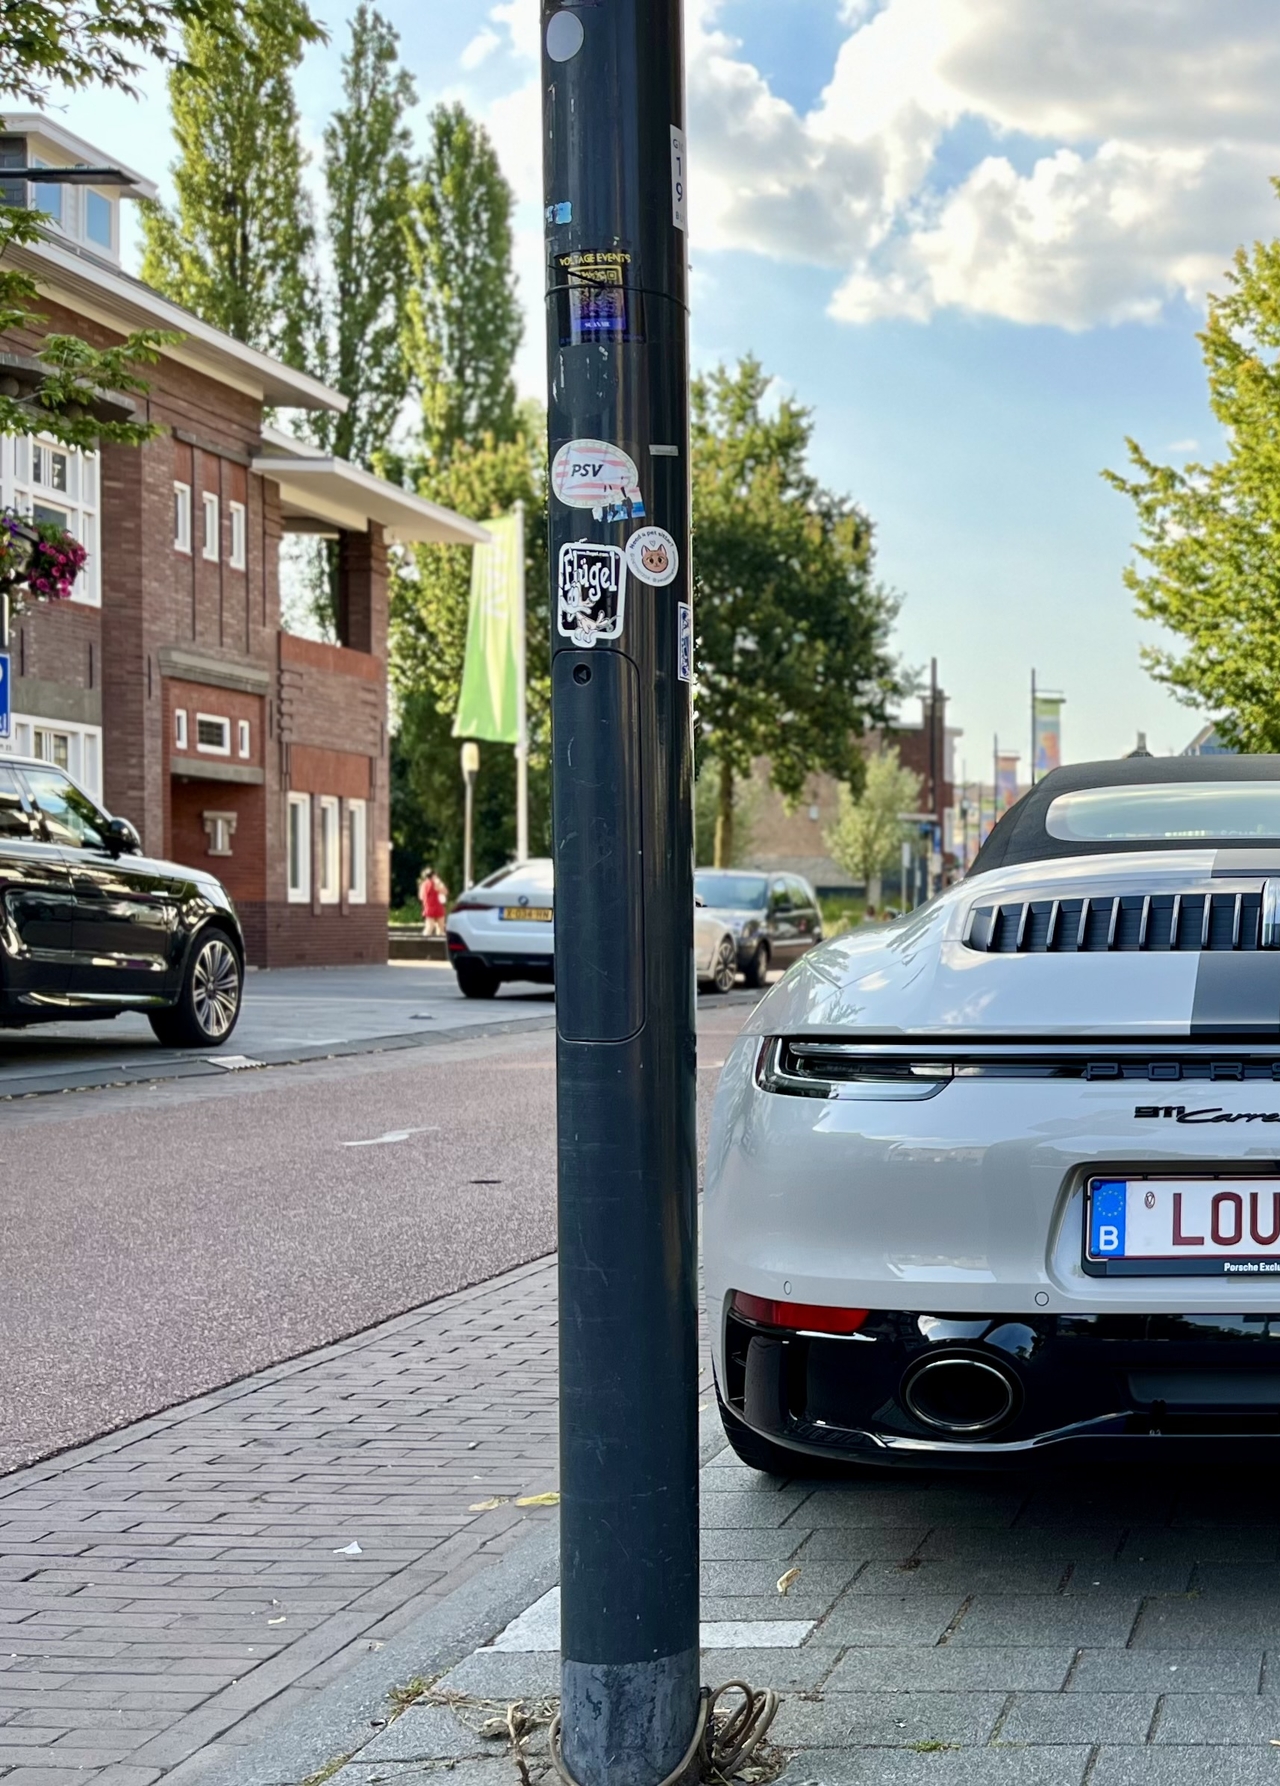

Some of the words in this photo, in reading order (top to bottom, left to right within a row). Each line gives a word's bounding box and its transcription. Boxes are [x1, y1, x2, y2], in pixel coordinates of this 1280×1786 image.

[560, 253, 596, 266] VOLTAGE
[596, 253, 631, 264] EVENTS
[571, 463, 603, 477] PSV
[564, 548, 617, 601] Flügel
[1134, 1105, 1185, 1118] 911
[1099, 1225, 1119, 1251] B
[1223, 1262, 1259, 1272] Porsche
